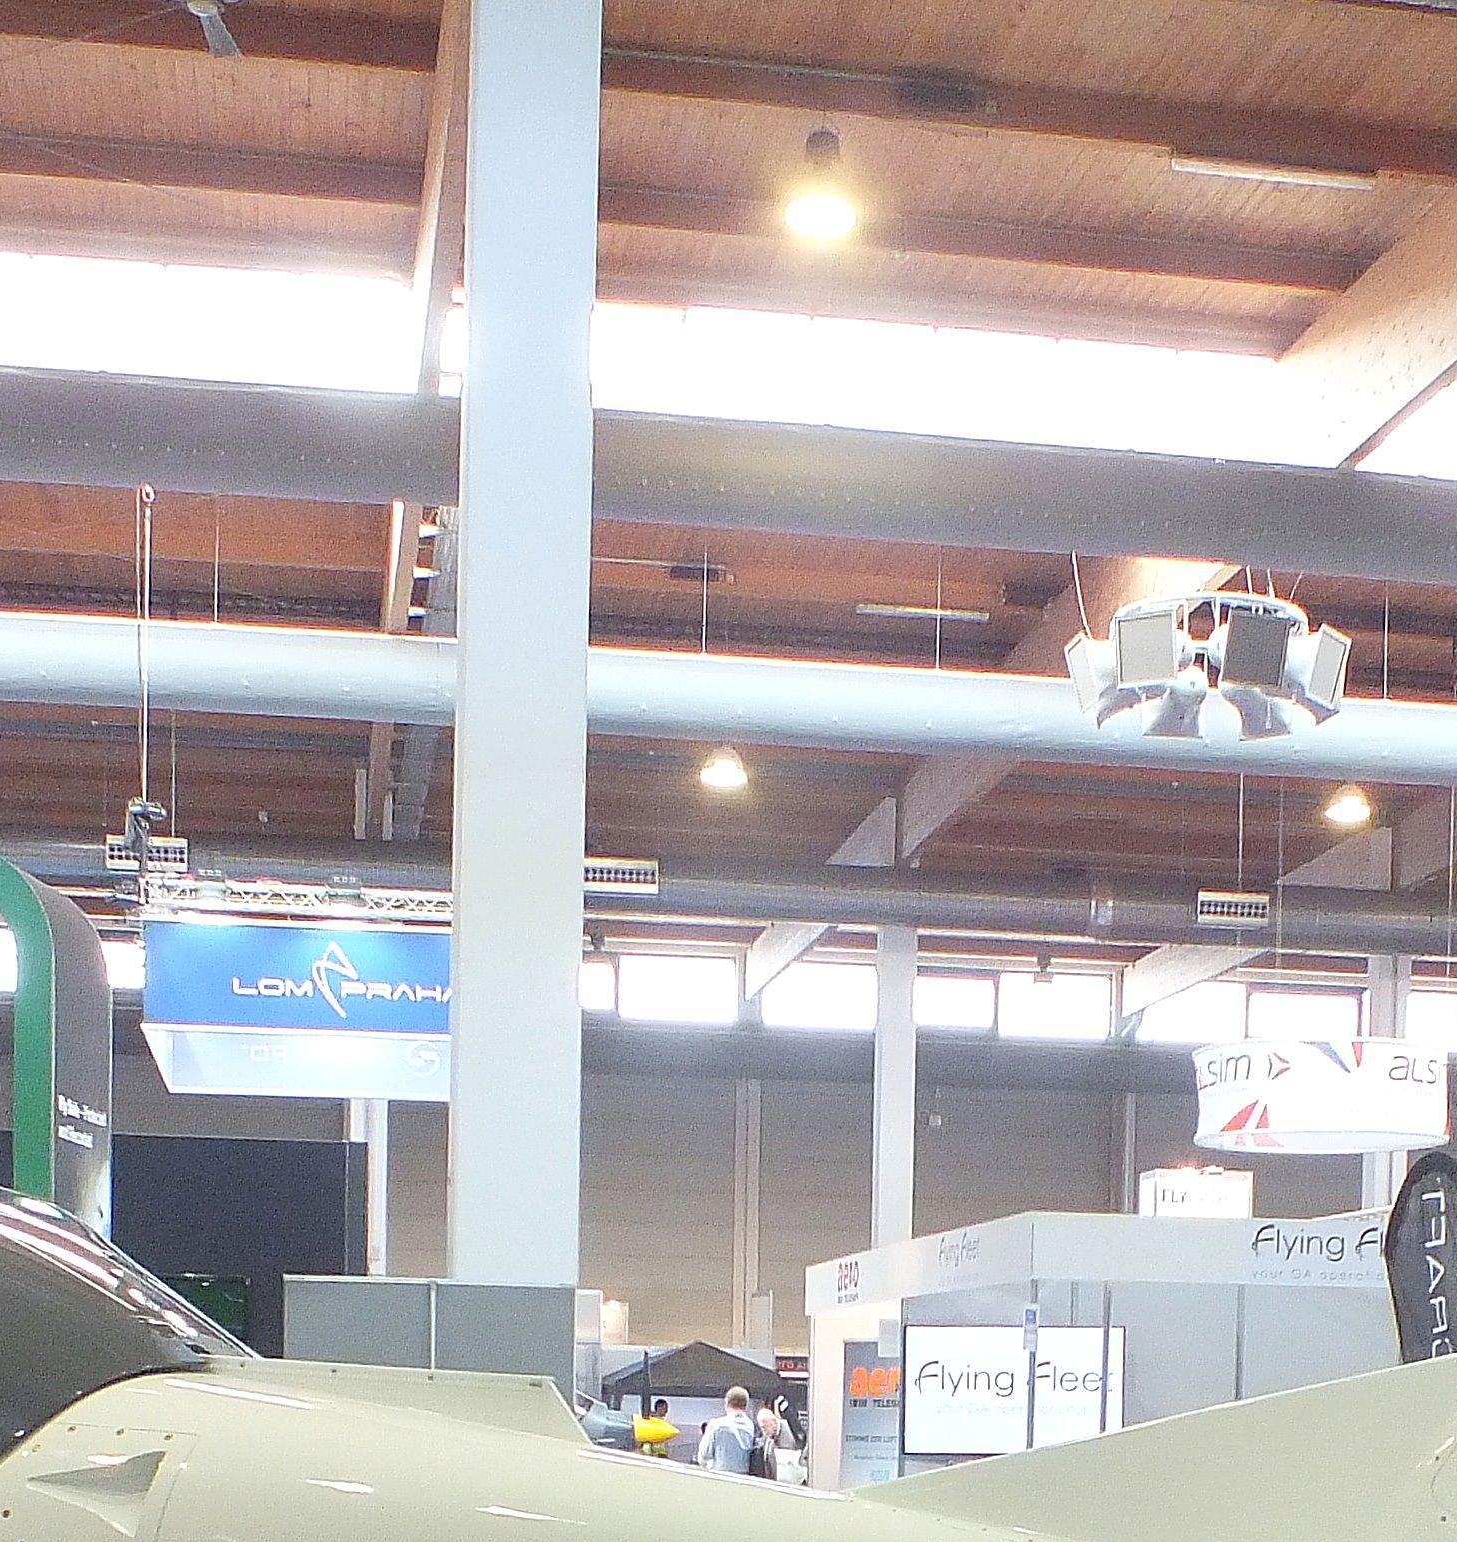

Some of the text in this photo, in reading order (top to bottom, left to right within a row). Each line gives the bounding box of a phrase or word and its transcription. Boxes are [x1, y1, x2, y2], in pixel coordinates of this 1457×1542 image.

[232, 976, 313, 998] LOM
[1251, 1224, 1345, 1262] Flying
[914, 1360, 1015, 1397] Flying
